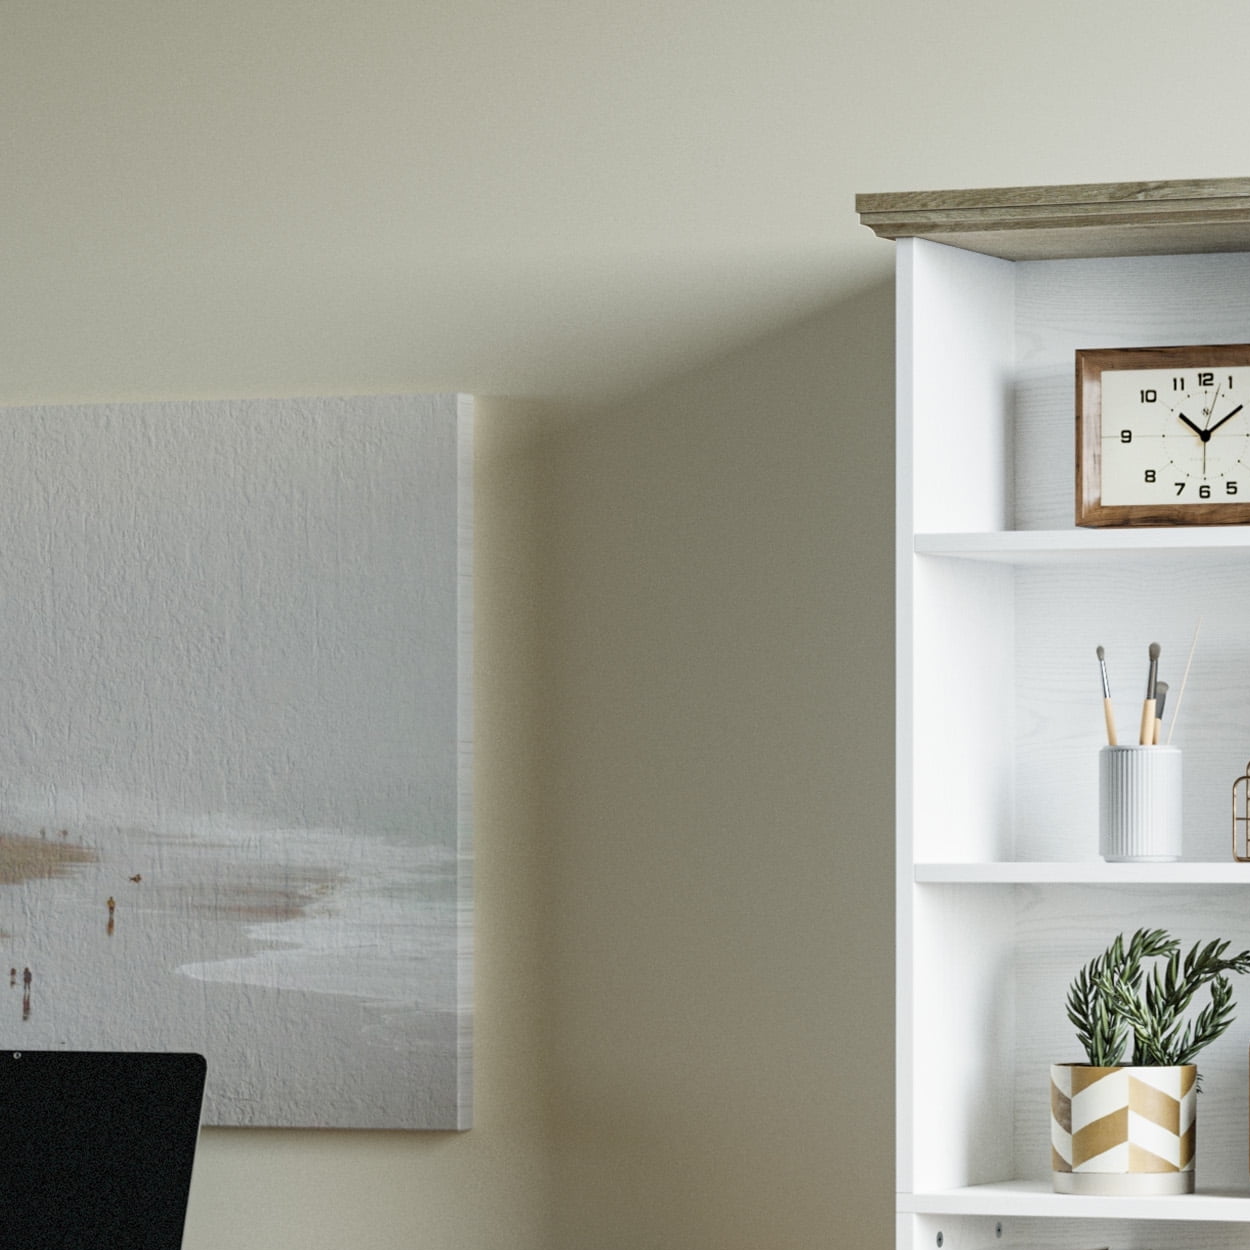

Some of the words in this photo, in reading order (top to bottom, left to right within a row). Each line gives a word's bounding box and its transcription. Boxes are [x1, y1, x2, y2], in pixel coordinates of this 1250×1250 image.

[1173, 377, 1185, 391] 11
[1198, 372, 1214, 386] 12
[1228, 376, 1234, 389] 1
[1140, 390, 1157, 403] 10
[1120, 430, 1132, 444] 9
[1144, 470, 1156, 483] 8
[1174, 482, 1186, 496] 7
[1199, 485, 1211, 499] 6
[1226, 482, 1238, 495] 5
